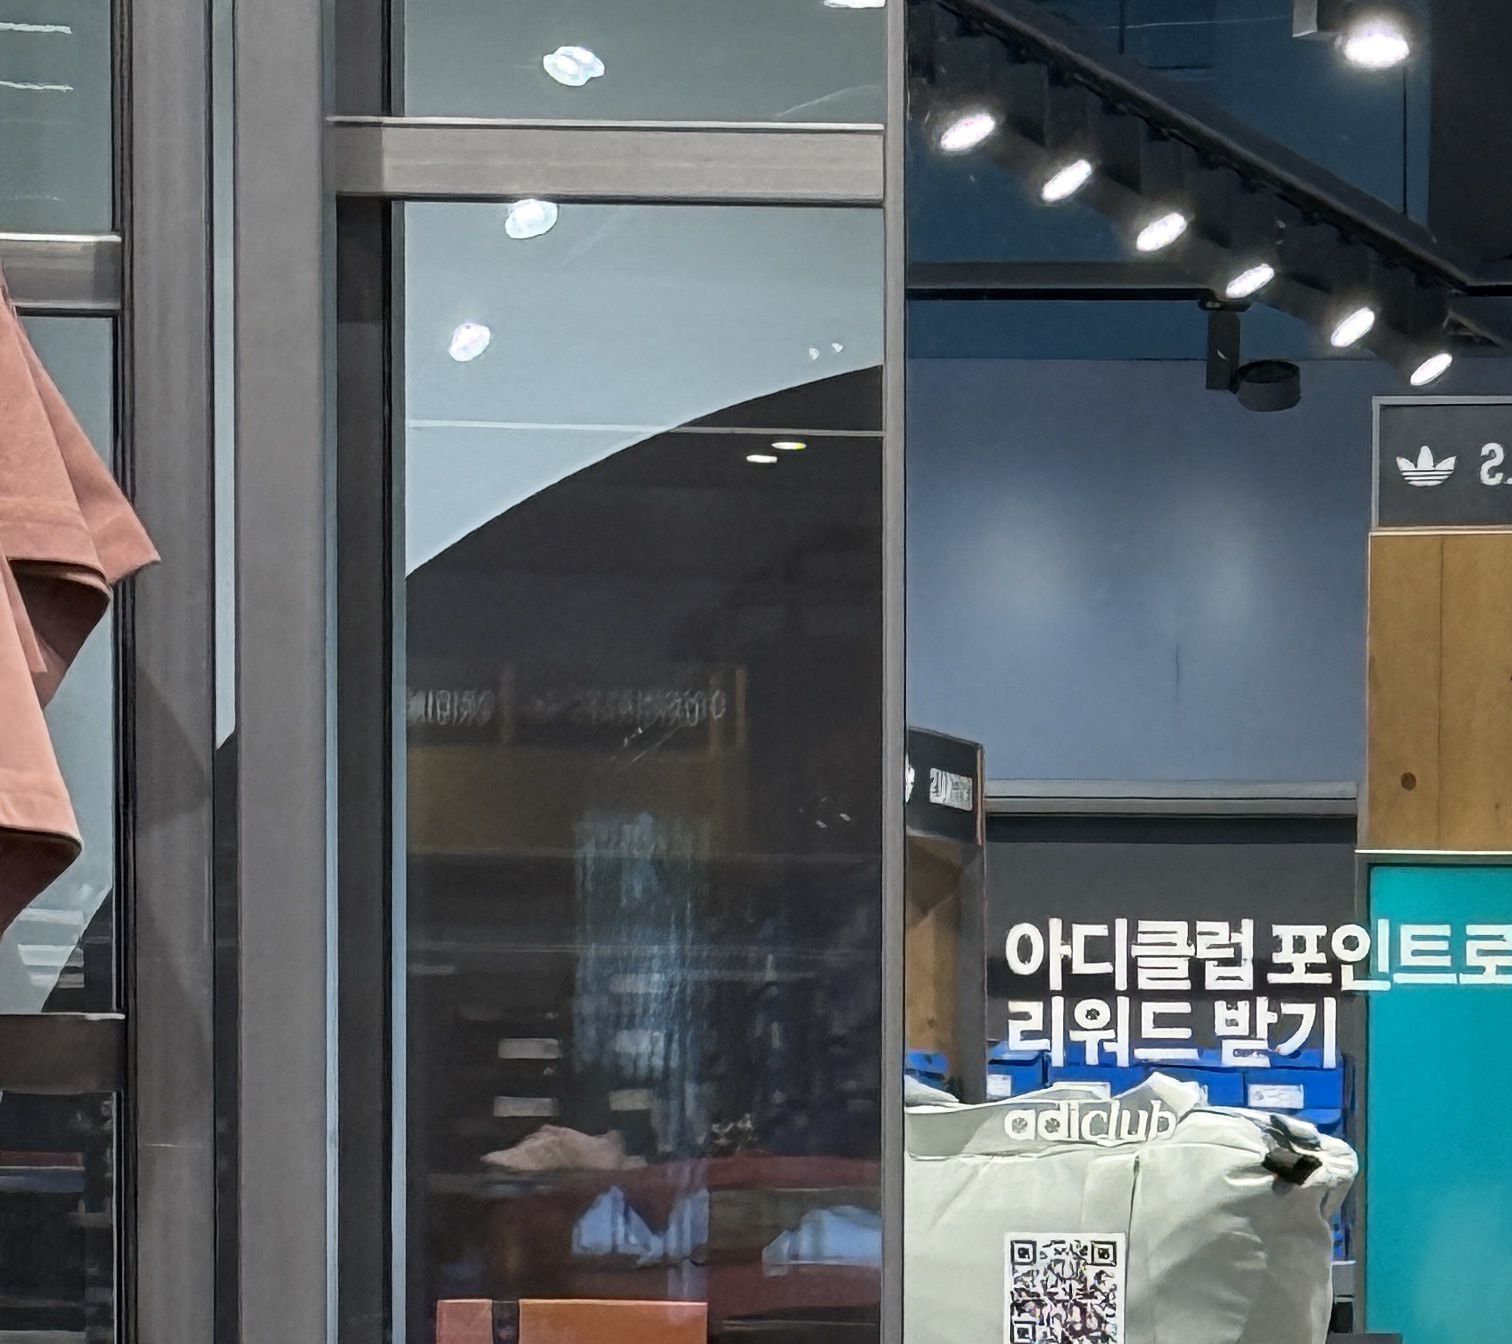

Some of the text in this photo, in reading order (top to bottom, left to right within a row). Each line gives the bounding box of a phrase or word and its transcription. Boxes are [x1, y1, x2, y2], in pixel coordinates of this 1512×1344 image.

[1006, 918, 1254, 990] 아디클럽
[1007, 996, 1337, 1069] 리워드 받기
[1004, 1099, 1177, 1143] adiclub
